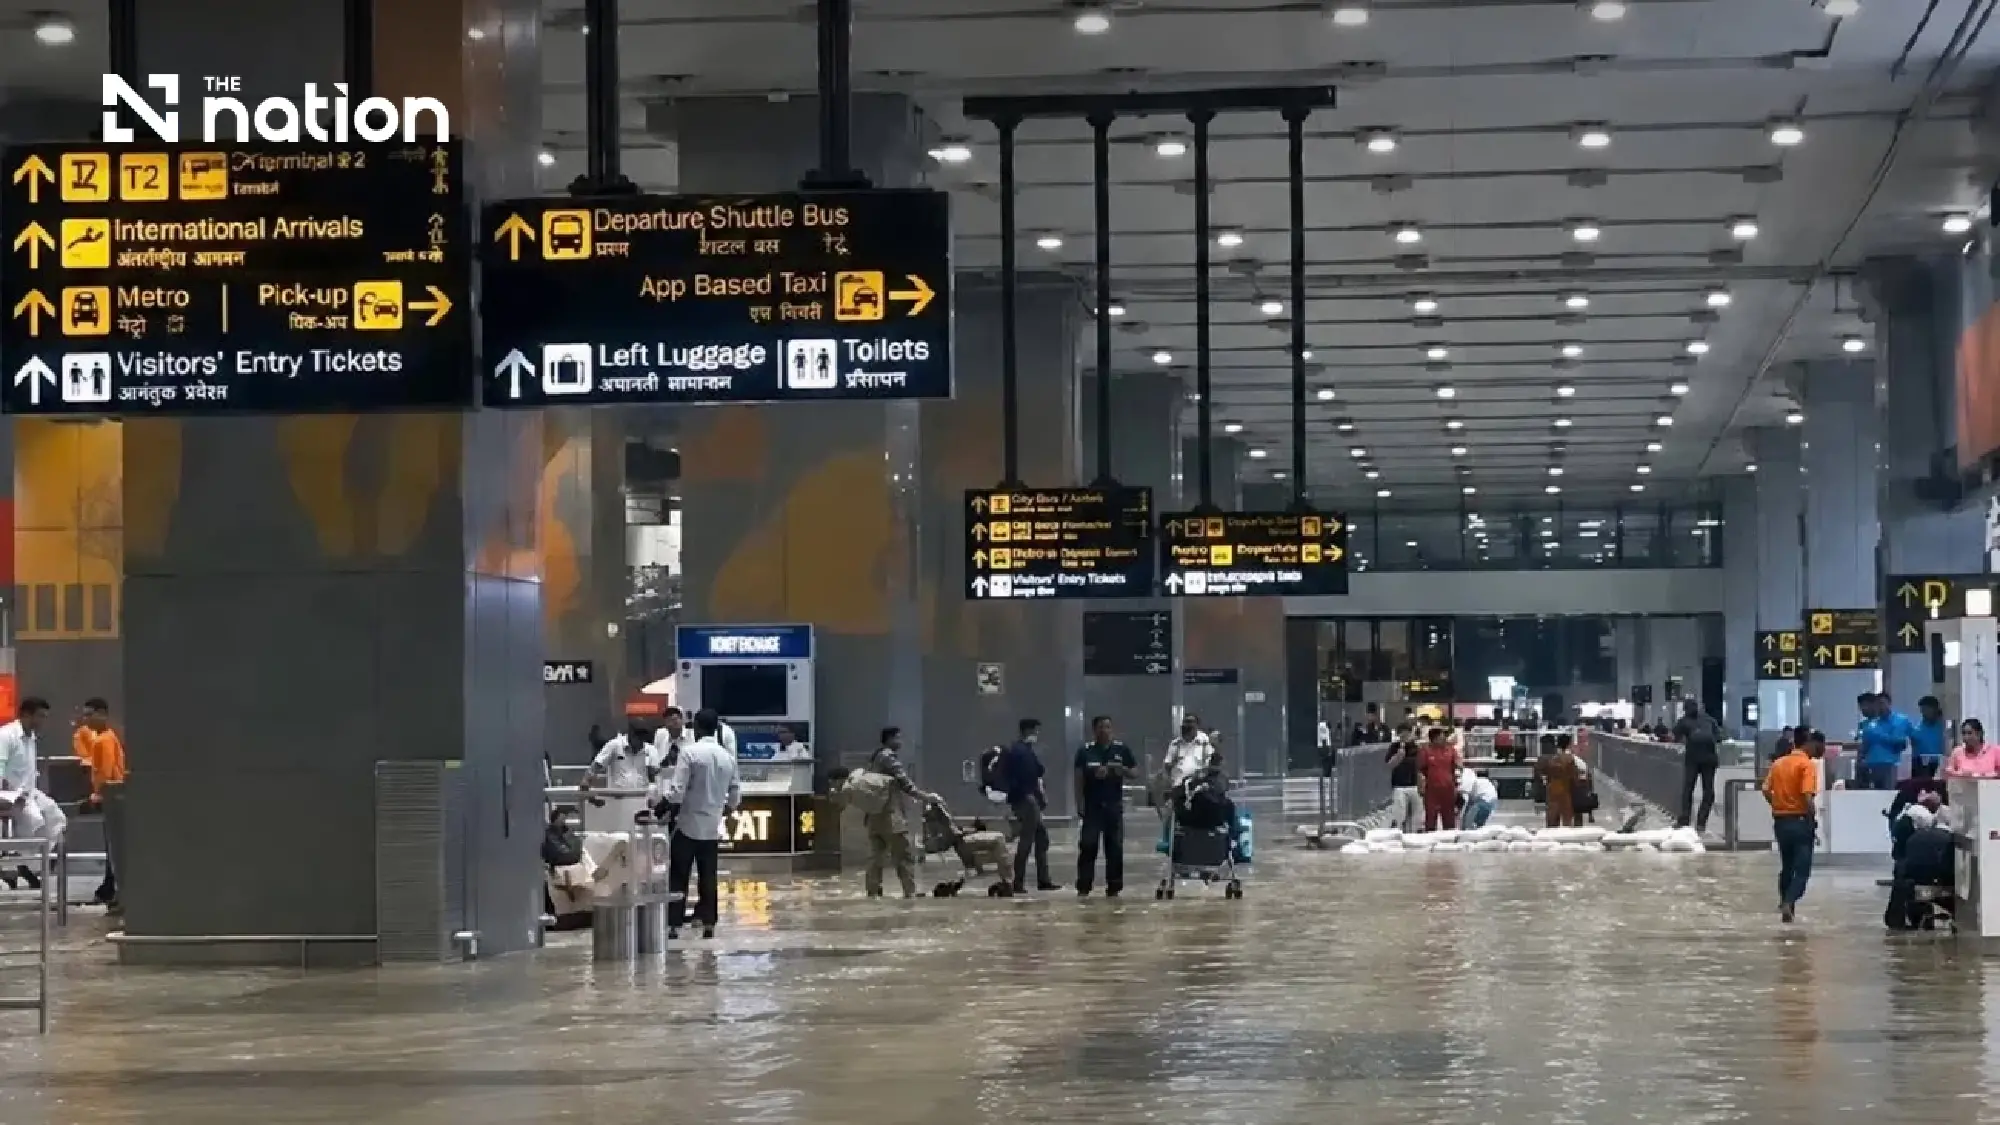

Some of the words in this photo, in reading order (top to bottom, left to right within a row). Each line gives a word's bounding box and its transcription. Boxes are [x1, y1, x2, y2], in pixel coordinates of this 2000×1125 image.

[124, 165, 159, 189] T2
[114, 217, 265, 241] International
[273, 215, 364, 240] Arrivals
[594, 208, 705, 233] Departure
[710, 205, 795, 229] Shuttle
[802, 204, 849, 226] Bus
[117, 285, 190, 308] Metro
[259, 283, 348, 309] Pick-up
[639, 274, 686, 302] App
[694, 272, 772, 295] Based
[780, 271, 827, 293] Taxi
[117, 351, 224, 376] Visitors'
[236, 350, 303, 378] Entry
[311, 348, 403, 373] Tickets
[600, 343, 649, 367] Left
[658, 342, 766, 369] Luggage
[843, 338, 929, 362] Toilets
